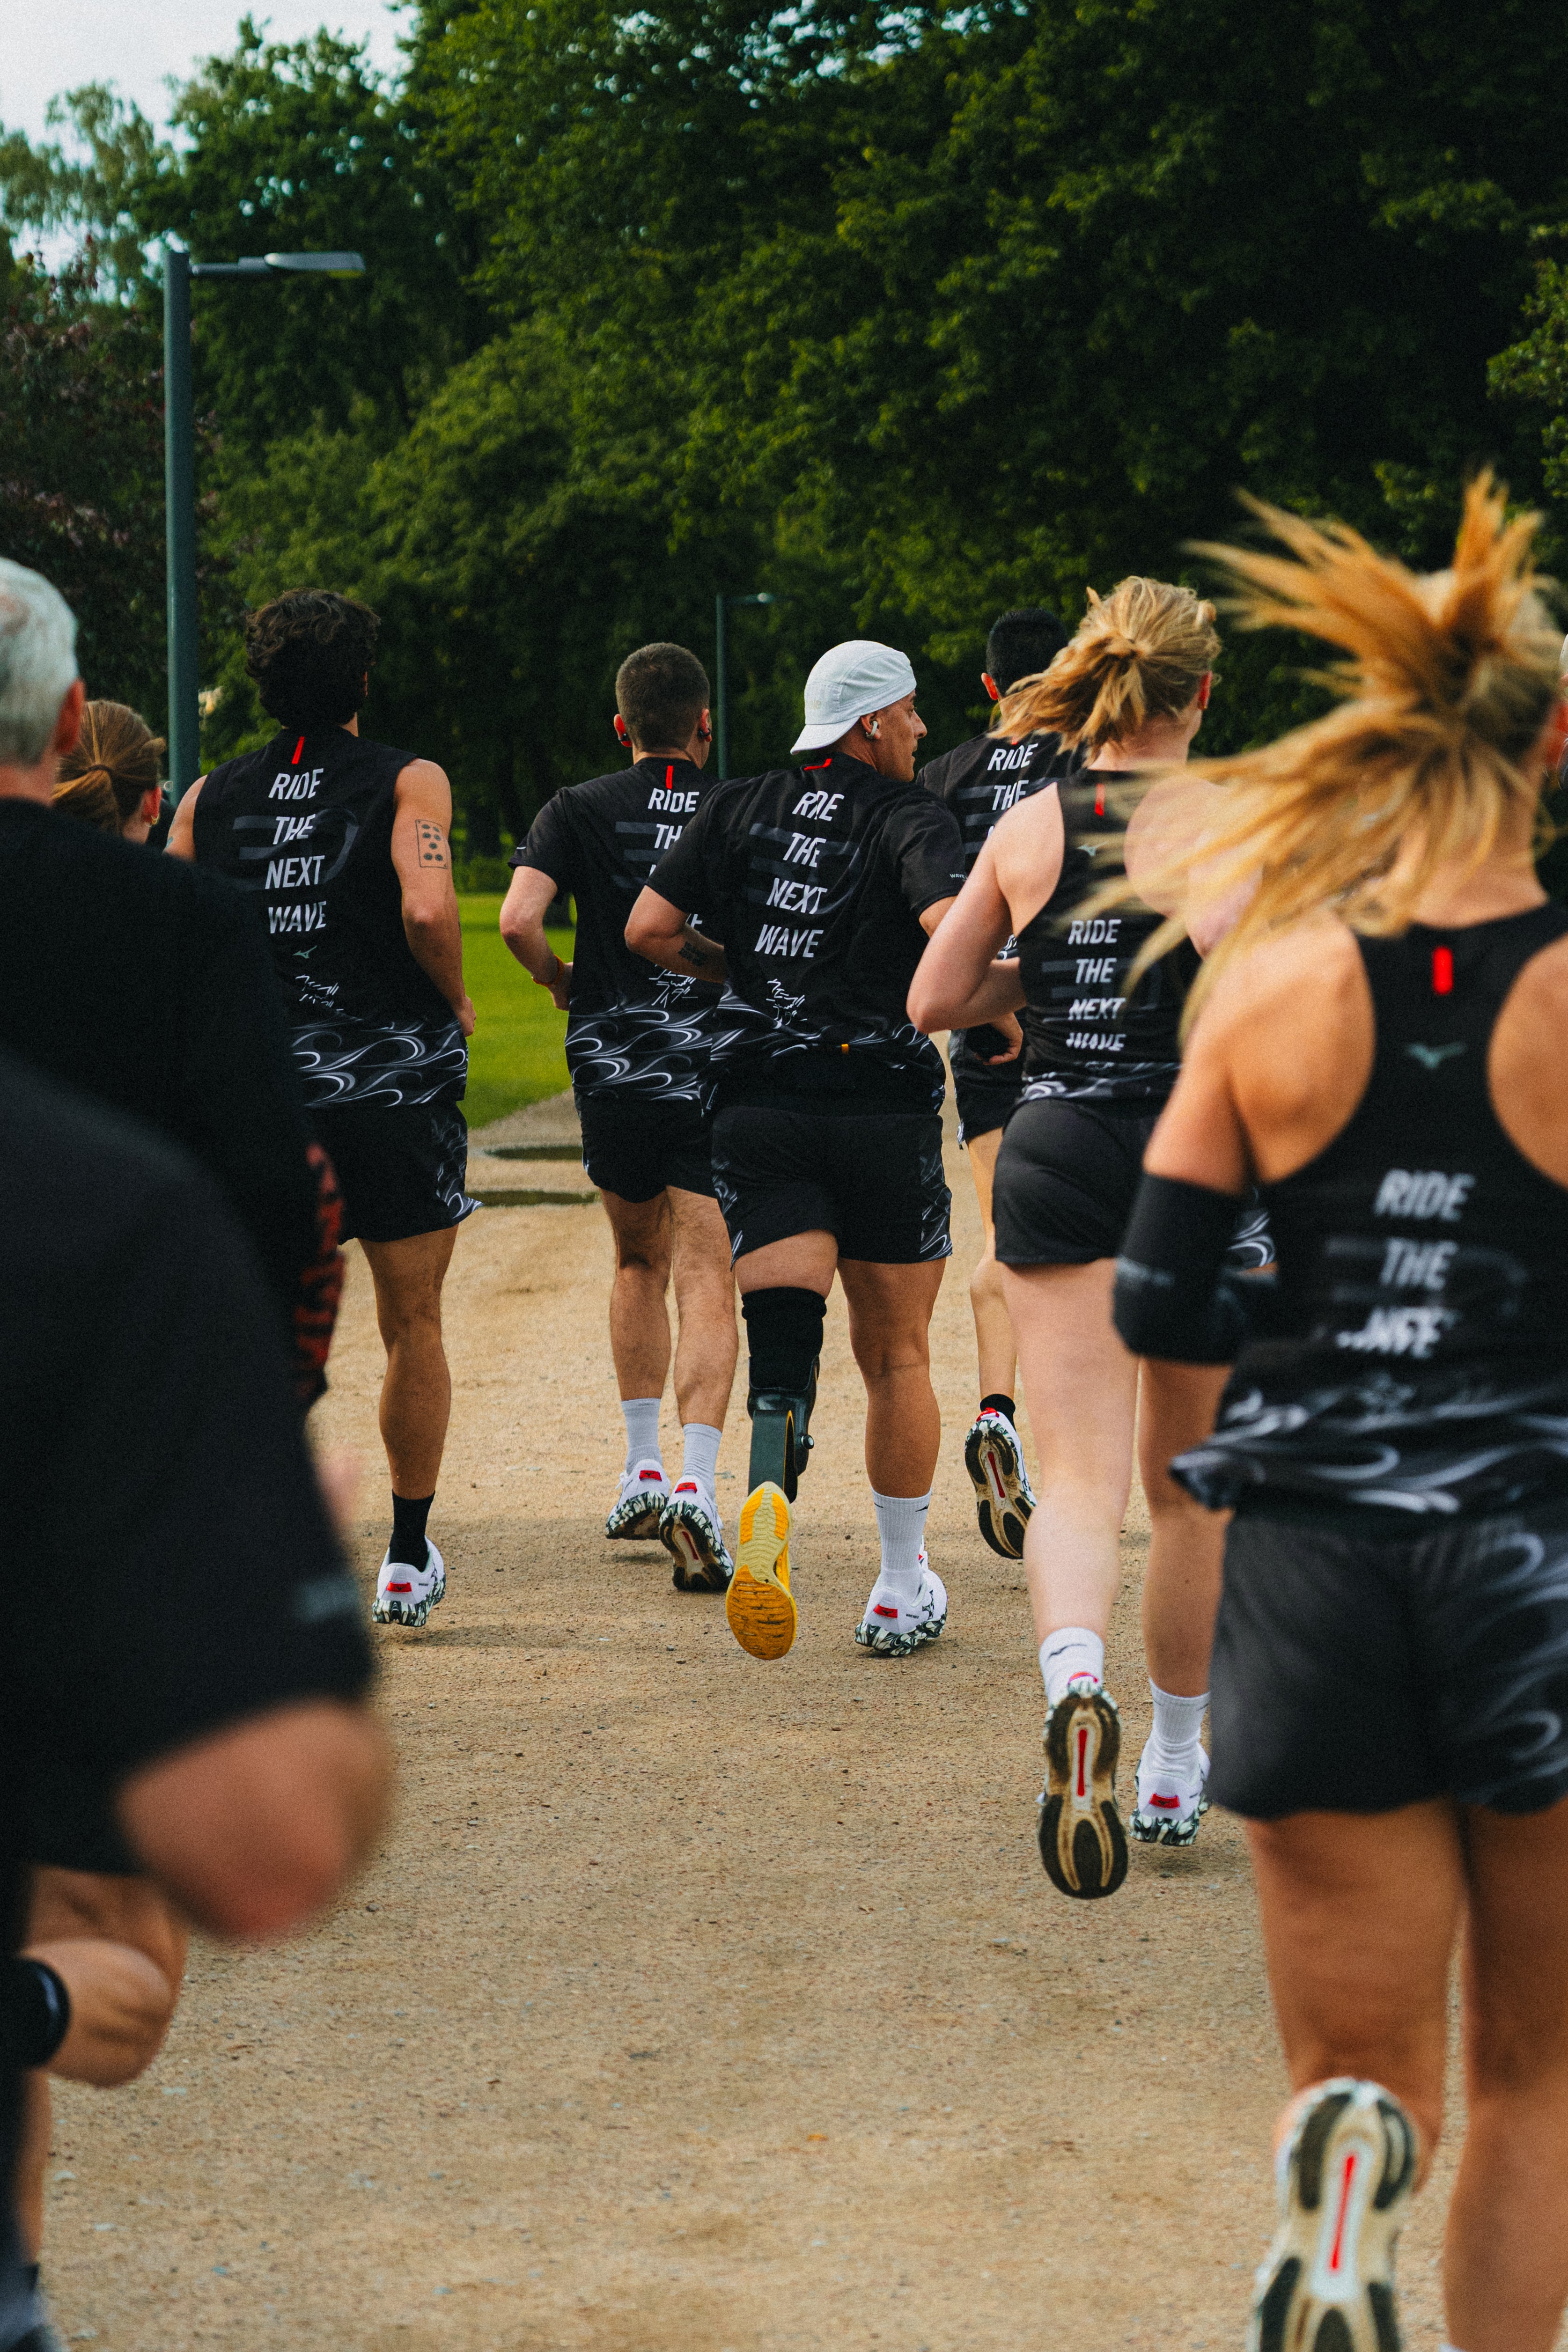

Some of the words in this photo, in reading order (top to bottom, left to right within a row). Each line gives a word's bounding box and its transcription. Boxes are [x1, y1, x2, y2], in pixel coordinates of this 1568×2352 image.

[987, 743, 1038, 771] RIDE
[268, 768, 324, 800] RIDE
[992, 780, 1029, 811] THE
[648, 787, 699, 813] RIDE
[272, 814, 316, 845] THE
[654, 823, 683, 850] TH
[783, 832, 827, 867] THE
[265, 855, 325, 889] NEXT
[766, 878, 828, 915] NEXT
[268, 901, 326, 933] WAVE
[1068, 919, 1122, 945] RIDE
[754, 924, 824, 958] WAVE
[1075, 958, 1117, 984] THE
[1067, 998, 1126, 1021] NEXT
[1376, 1169, 1472, 1219] RIDE
